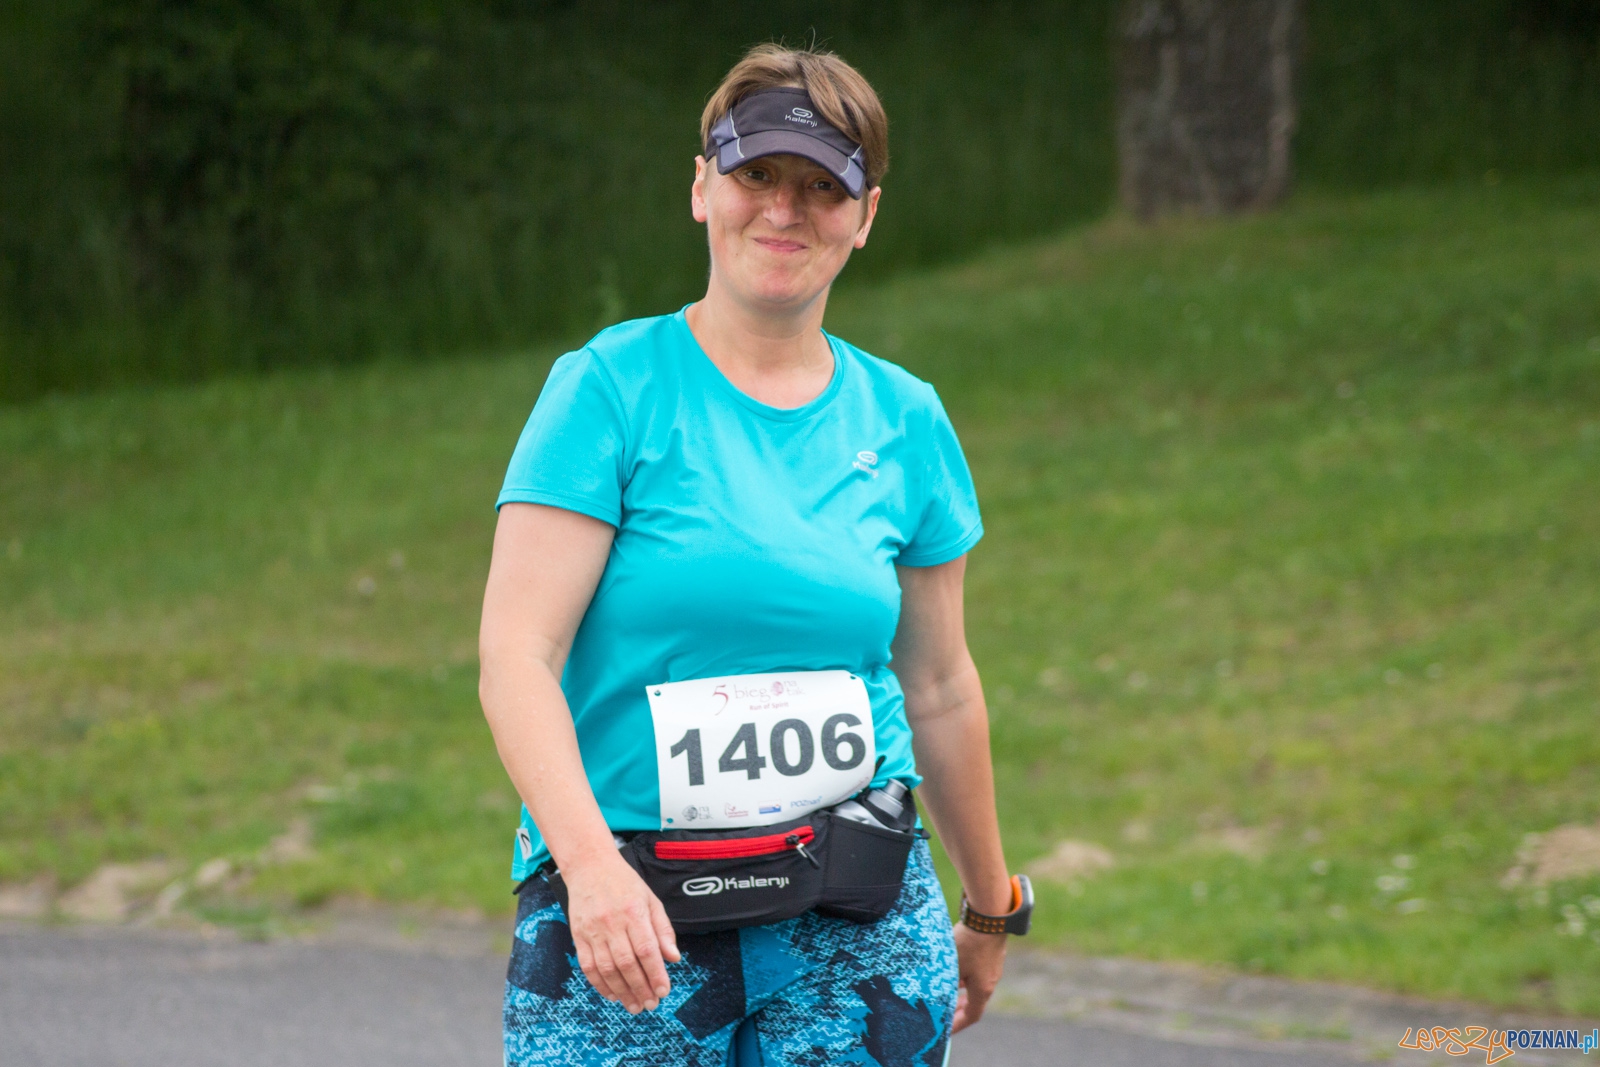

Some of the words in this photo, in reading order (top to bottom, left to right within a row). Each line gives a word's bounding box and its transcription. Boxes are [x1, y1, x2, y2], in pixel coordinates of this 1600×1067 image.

[785, 114, 818, 127] Kalenji
[712, 684, 729, 716] 5
[733, 684, 771, 703] bieg
[771, 701, 789, 710] Spirit
[670, 712, 867, 787] 1406
[724, 876, 790, 890] Kalenji
